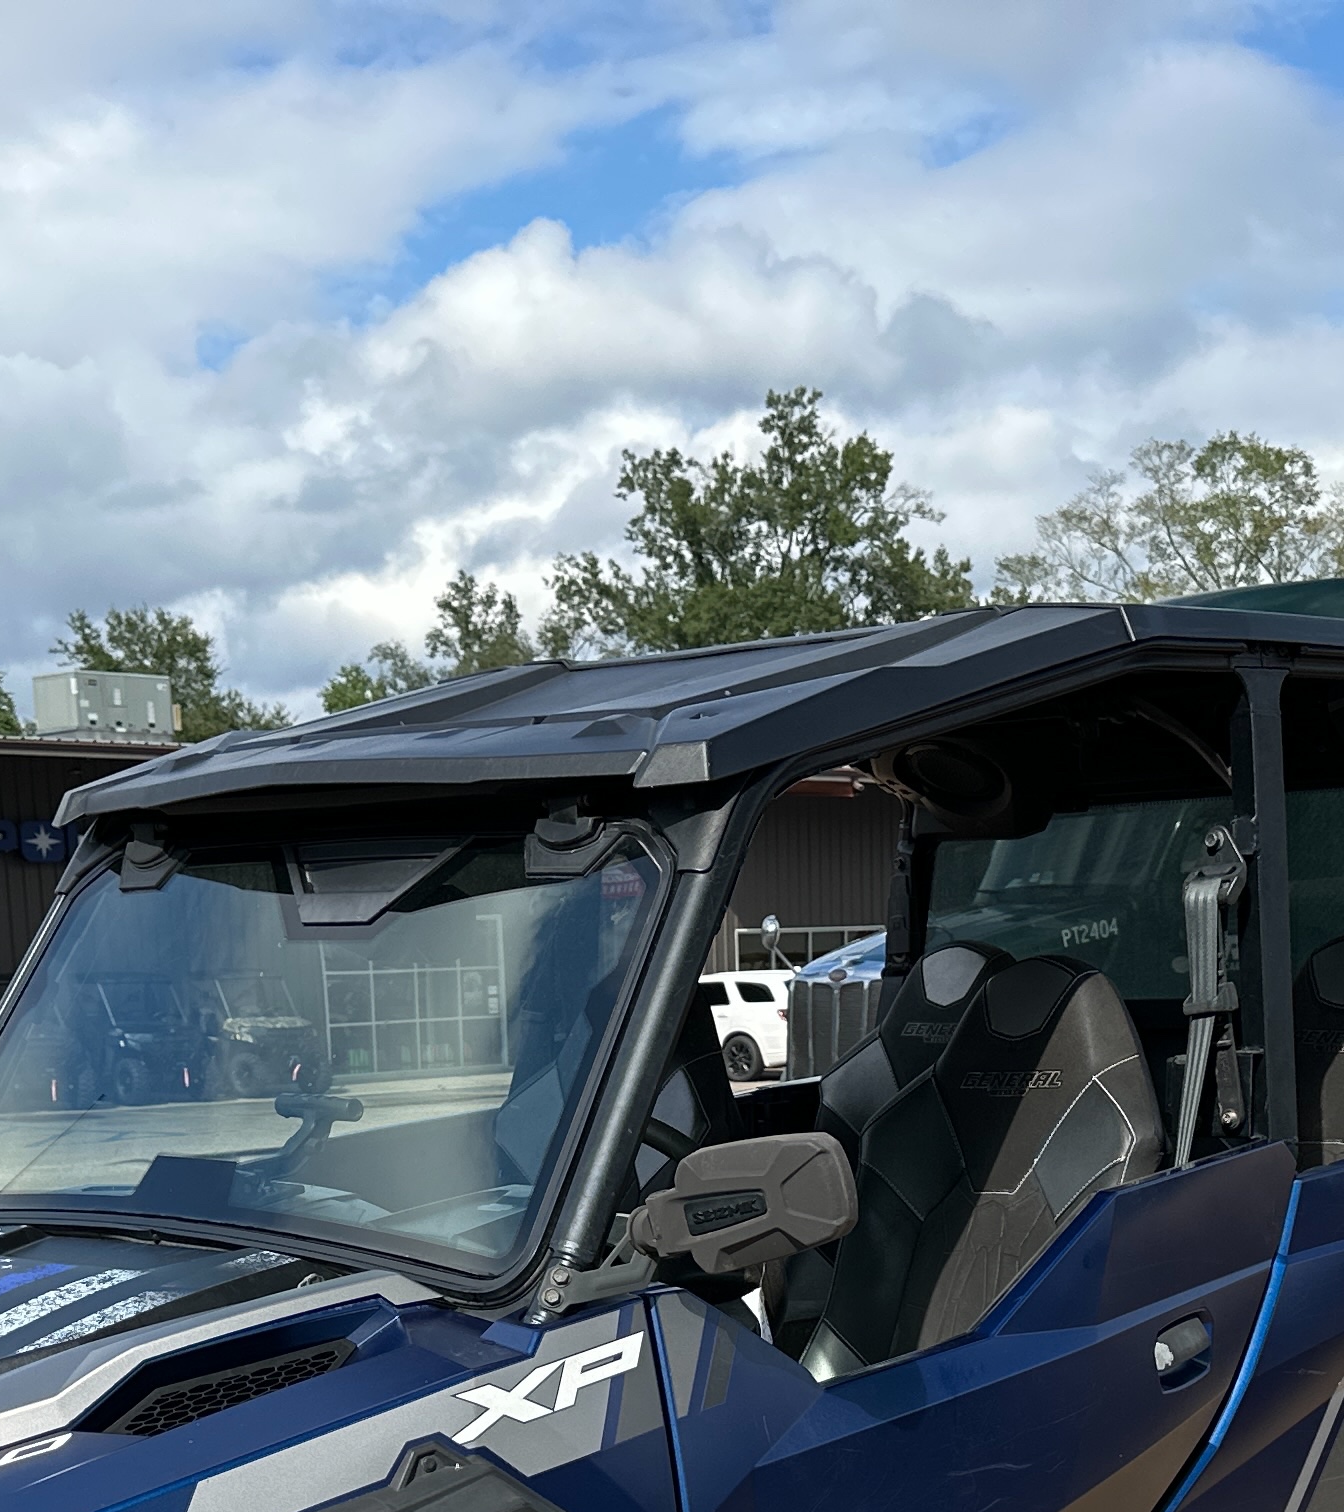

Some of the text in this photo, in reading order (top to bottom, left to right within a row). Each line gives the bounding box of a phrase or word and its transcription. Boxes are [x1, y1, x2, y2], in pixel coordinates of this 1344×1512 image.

[1061, 917, 1119, 949] PT2404
[960, 1070, 1063, 1089] GENERAL
[691, 1199, 762, 1226] SEIZMIK
[451, 1330, 645, 1445] XP
